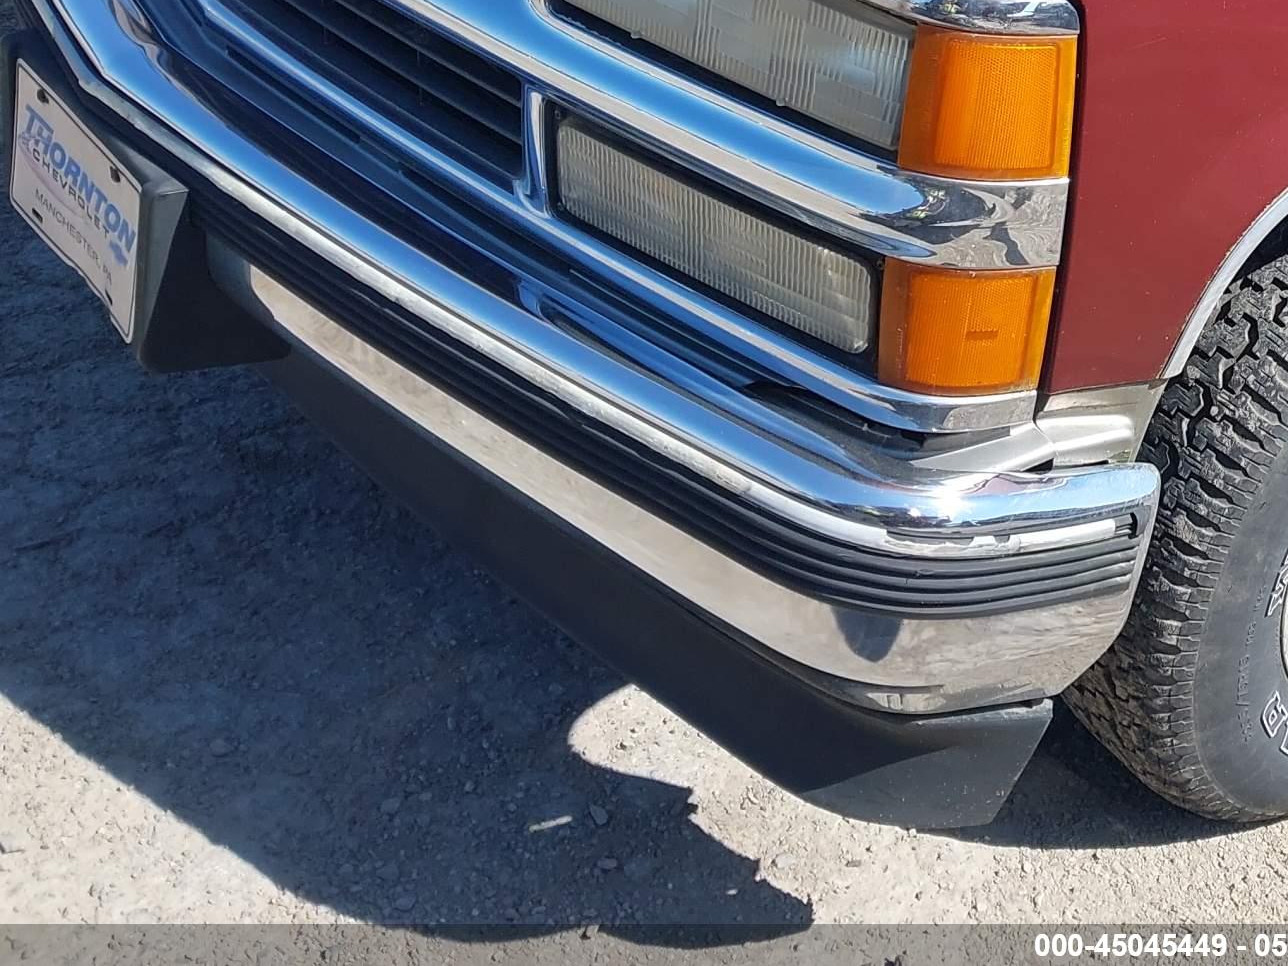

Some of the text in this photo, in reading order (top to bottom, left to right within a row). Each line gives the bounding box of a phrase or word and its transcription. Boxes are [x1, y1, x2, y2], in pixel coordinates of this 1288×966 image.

[25, 104, 136, 254] THORNTON
[32, 147, 110, 239] CHEVROLET
[103, 264, 113, 285] PA
